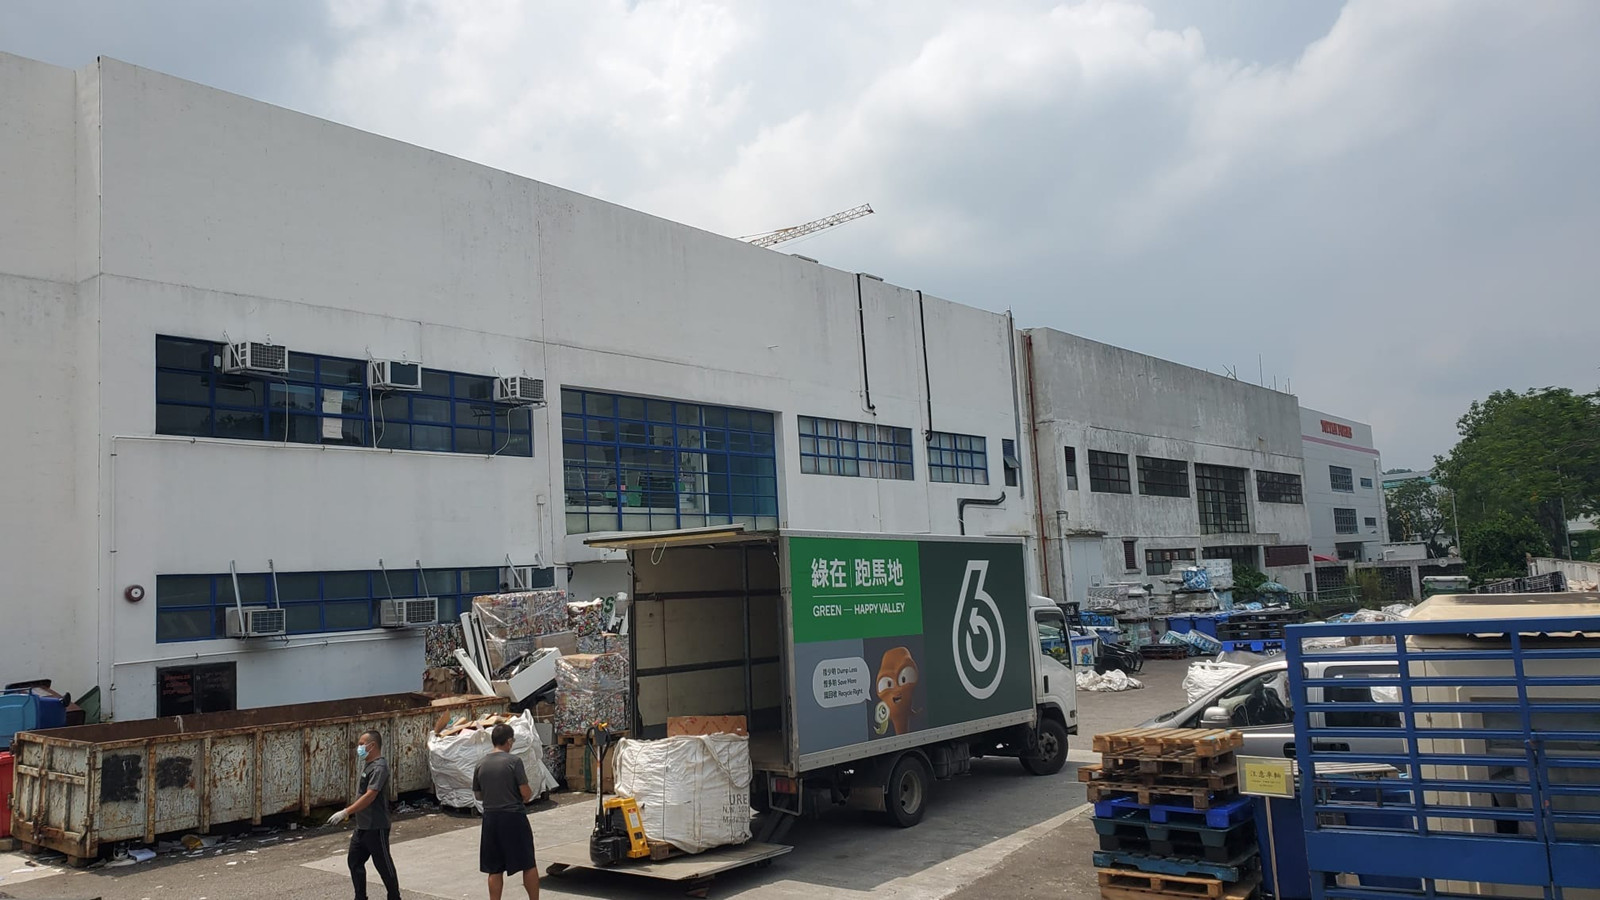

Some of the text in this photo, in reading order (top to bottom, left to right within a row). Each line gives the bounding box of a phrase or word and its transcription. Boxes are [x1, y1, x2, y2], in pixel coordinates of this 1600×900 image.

[811, 558, 904, 588] 綠在 跑馬地
[812, 602, 905, 617] GREEN HAPPY VALLEY
